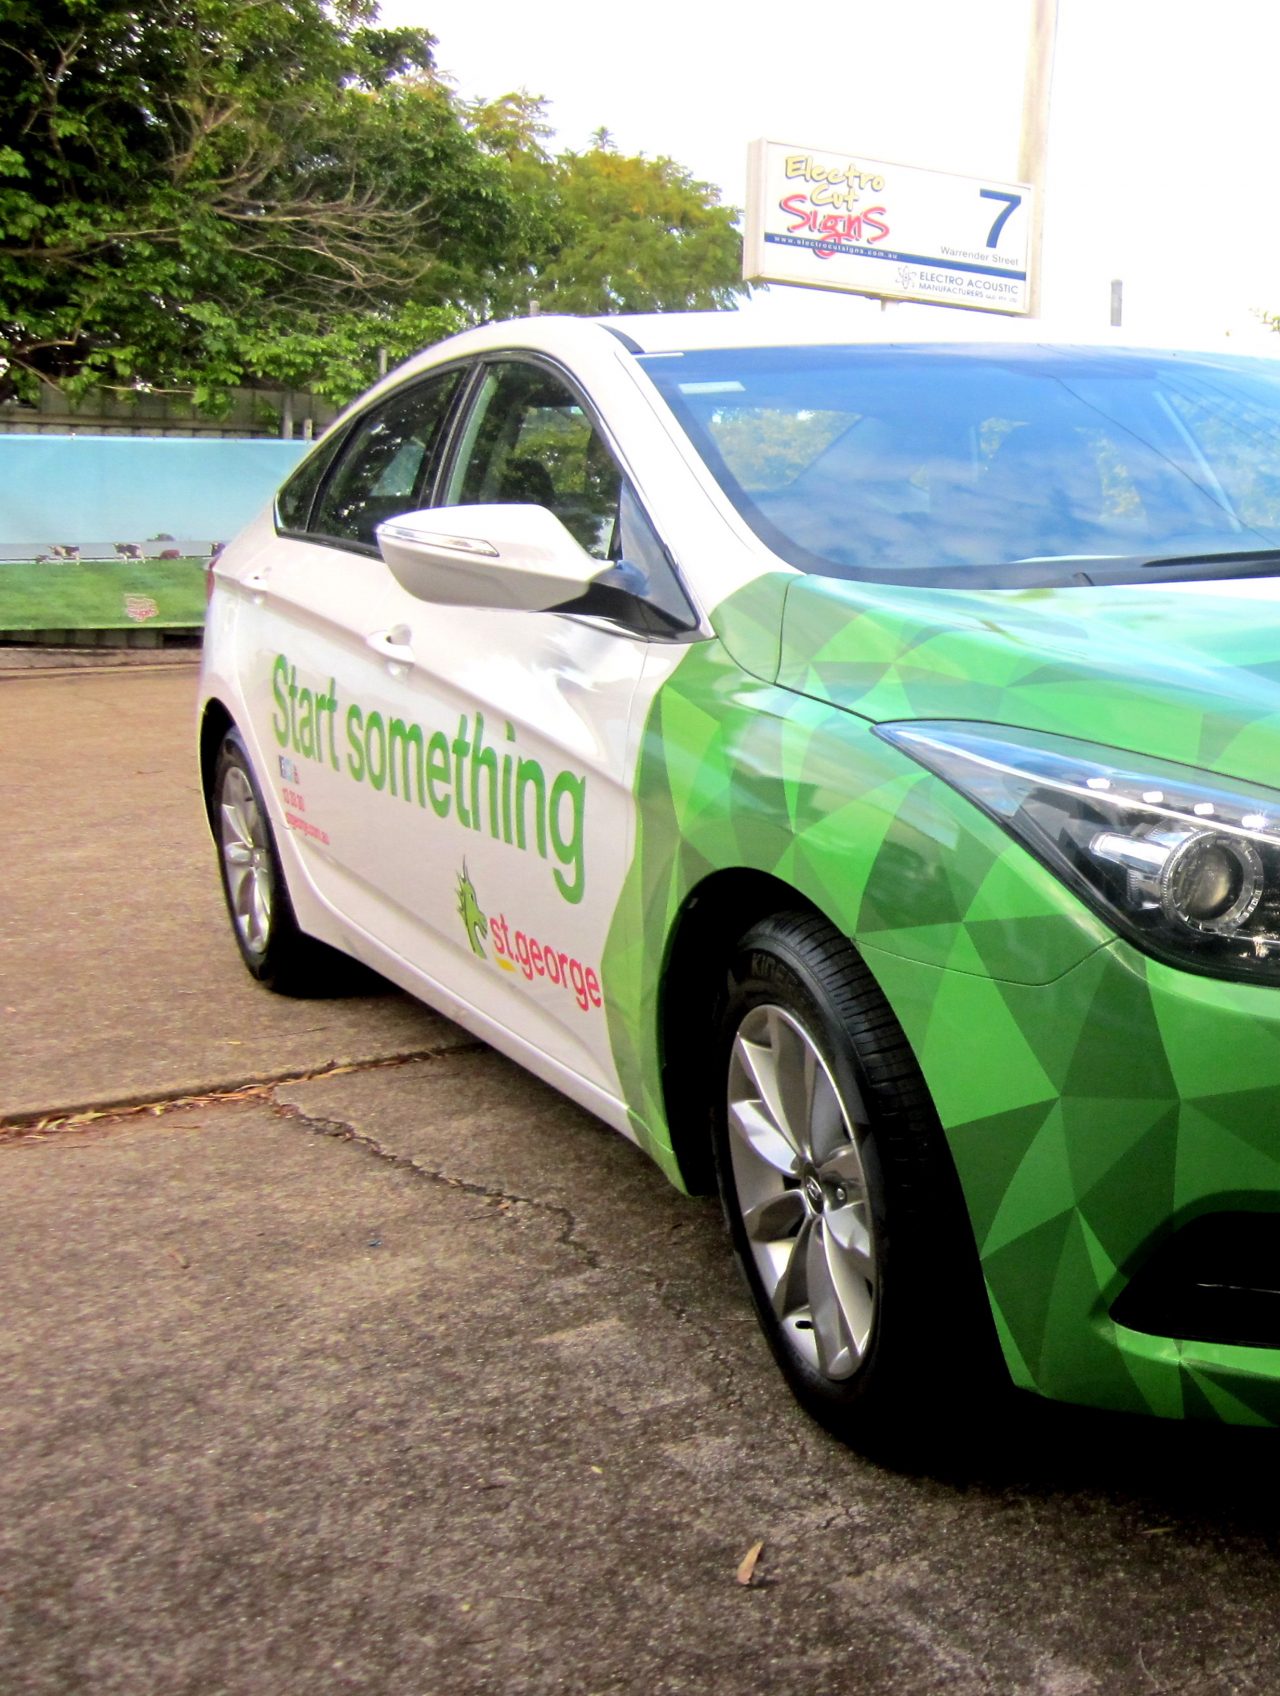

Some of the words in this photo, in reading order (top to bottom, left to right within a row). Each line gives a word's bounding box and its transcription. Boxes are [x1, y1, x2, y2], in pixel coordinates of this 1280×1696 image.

[785, 155, 885, 191] Electro
[810, 183, 859, 211] Cut
[979, 188, 1022, 248] 7
[940, 245, 989, 263] Warrender
[991, 253, 1019, 266] Street
[918, 282, 984, 299] MANUFACTURERS
[919, 270, 964, 287] ELECTRO
[967, 278, 1019, 295] ACOUSTIC
[272, 653, 340, 772] Start
[346, 703, 586, 905] something
[489, 913, 602, 1012] st.george
